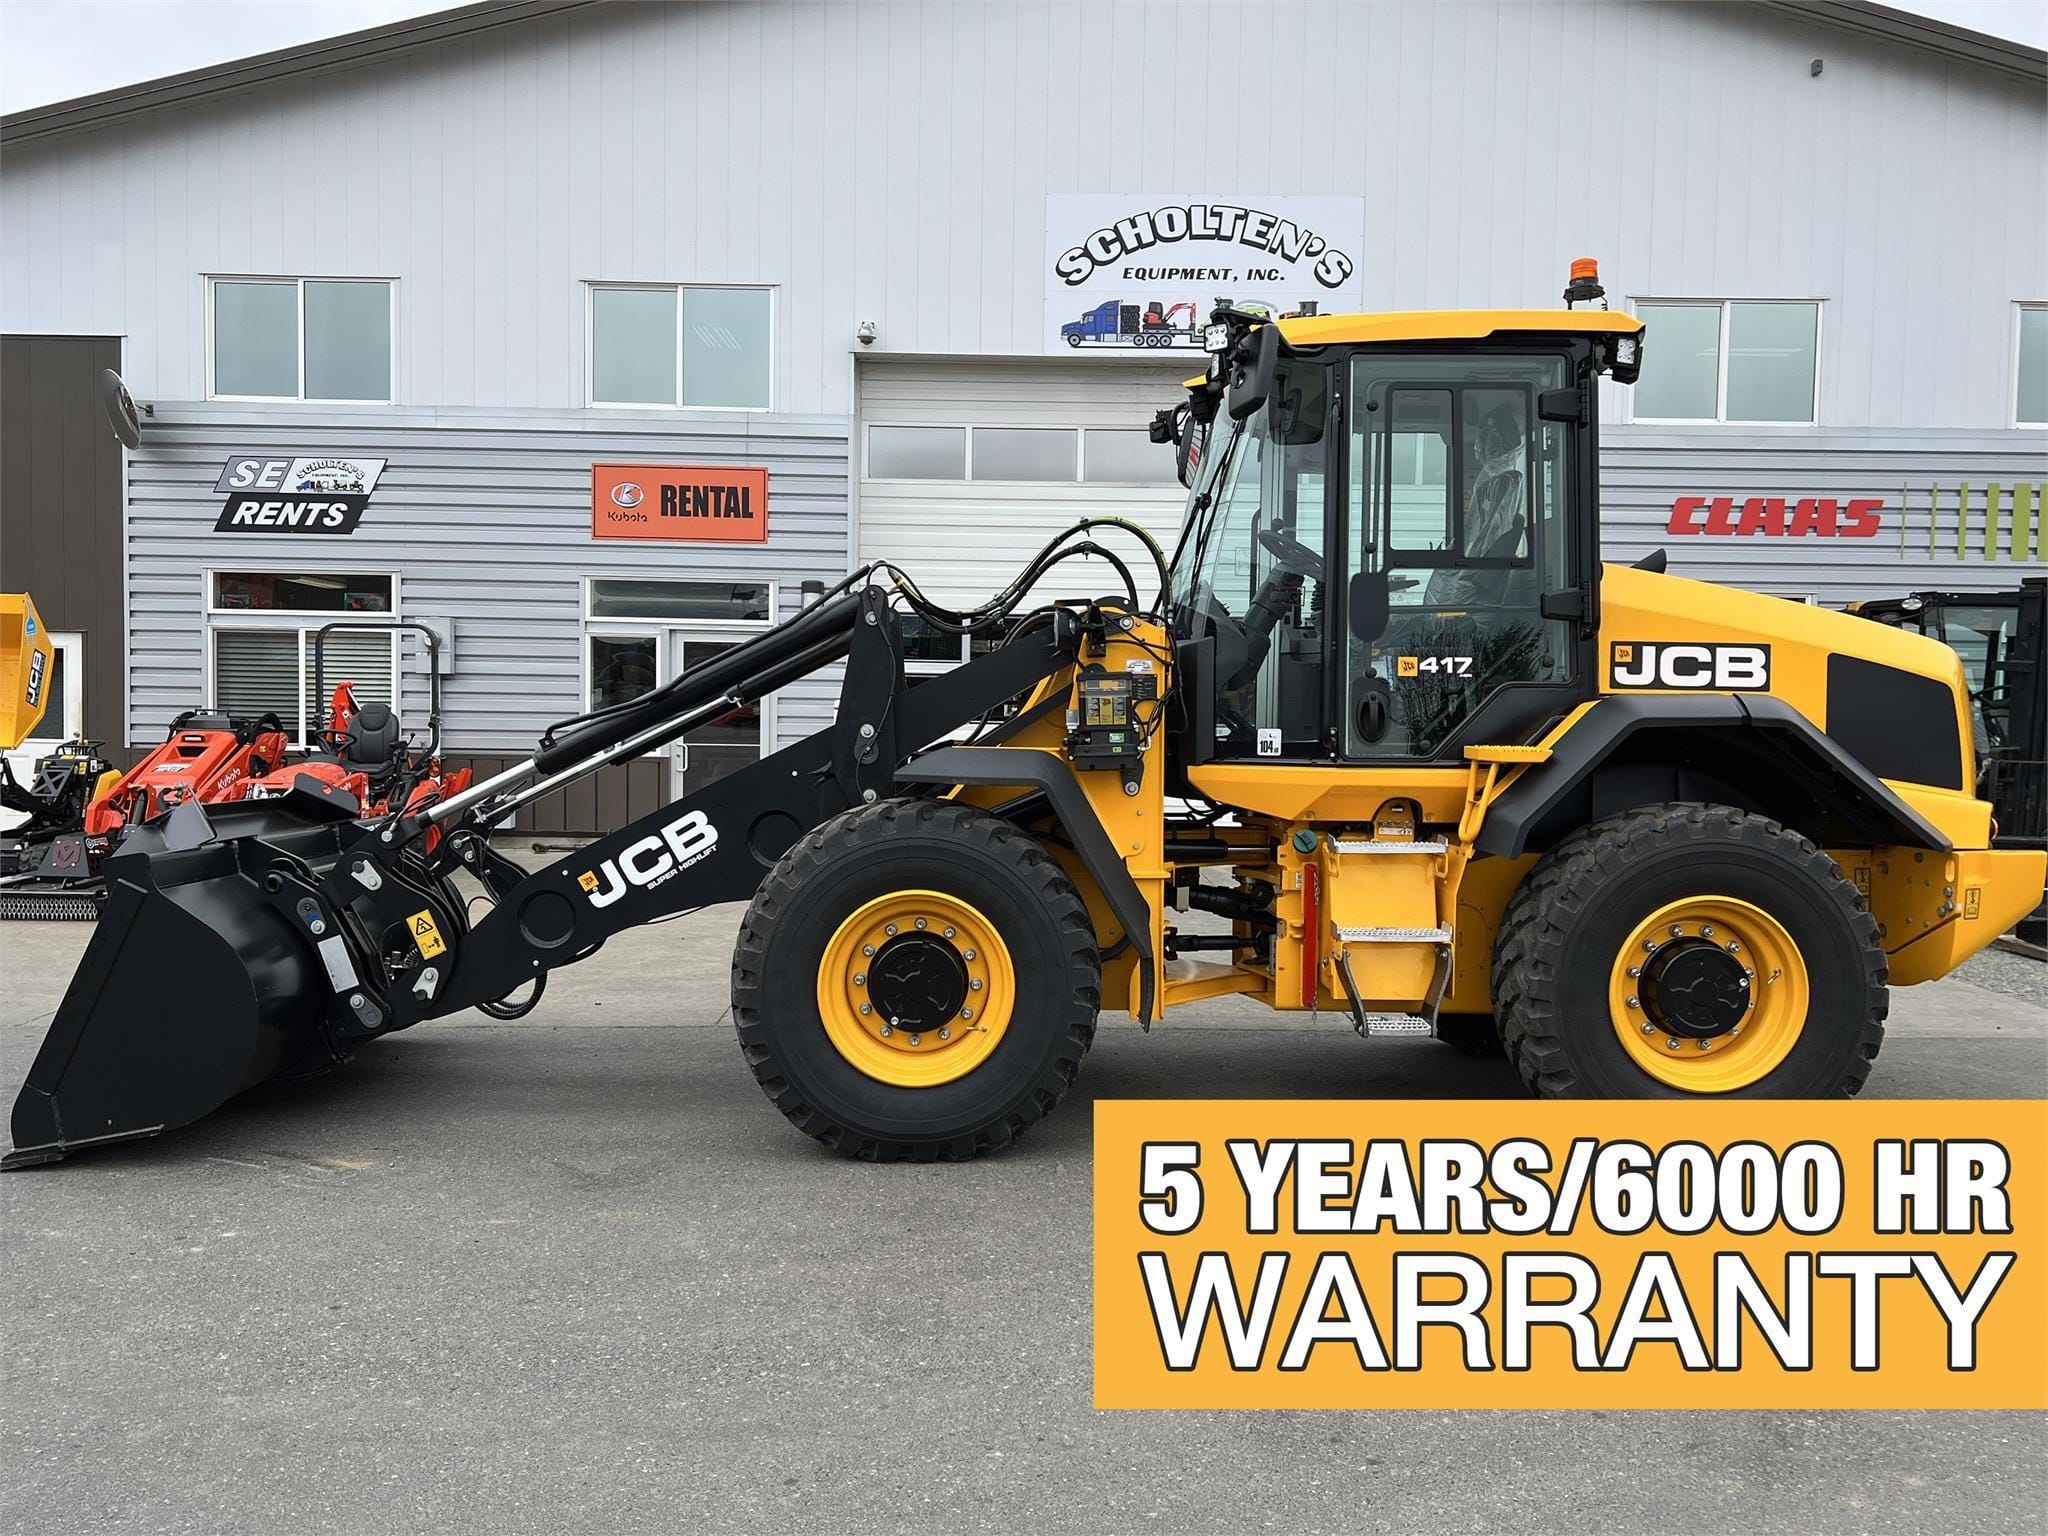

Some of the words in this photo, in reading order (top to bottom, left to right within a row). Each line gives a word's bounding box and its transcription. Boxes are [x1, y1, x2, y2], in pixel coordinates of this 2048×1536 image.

[1055, 204, 1354, 289] SCHOLTEN'S
[1122, 267, 1239, 283] EQUIPMENT,
[1246, 268, 1286, 282] INC.
[228, 460, 289, 489] SE
[231, 501, 349, 527] RENTS
[660, 484, 754, 519] RENTAL
[607, 511, 648, 523] Kubota
[1666, 496, 1885, 538] CLAAS
[28, 650, 42, 704] JCB
[1419, 656, 1473, 674] 417
[1614, 645, 1767, 688] JCB
[1260, 740, 1273, 753] 104
[217, 768, 241, 790] Kubota
[588, 810, 719, 909] JCB
[647, 868, 679, 890] SUPER
